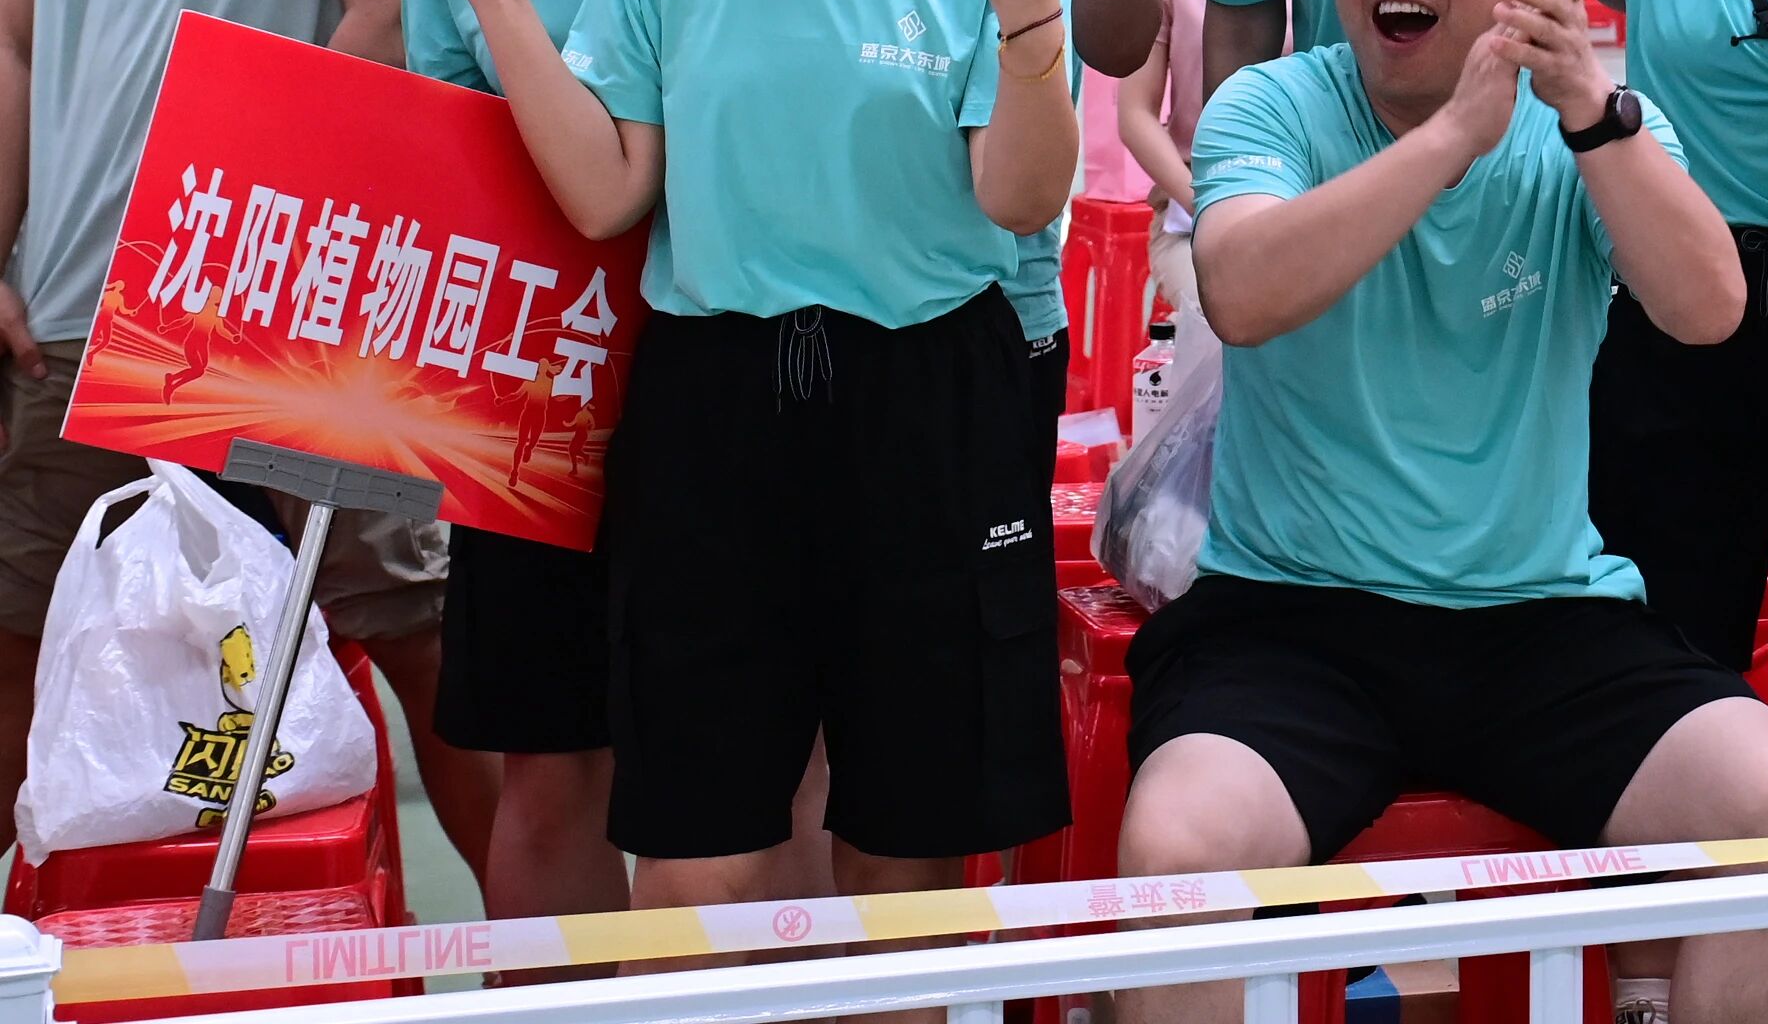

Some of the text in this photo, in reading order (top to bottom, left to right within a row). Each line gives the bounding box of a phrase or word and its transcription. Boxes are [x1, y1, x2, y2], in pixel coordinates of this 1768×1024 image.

[861, 42, 951, 72] 盛京大东城
[148, 163, 619, 407] 沈阳植物园工会
[990, 519, 1025, 538] KELME
[168, 777, 233, 800] SAN
